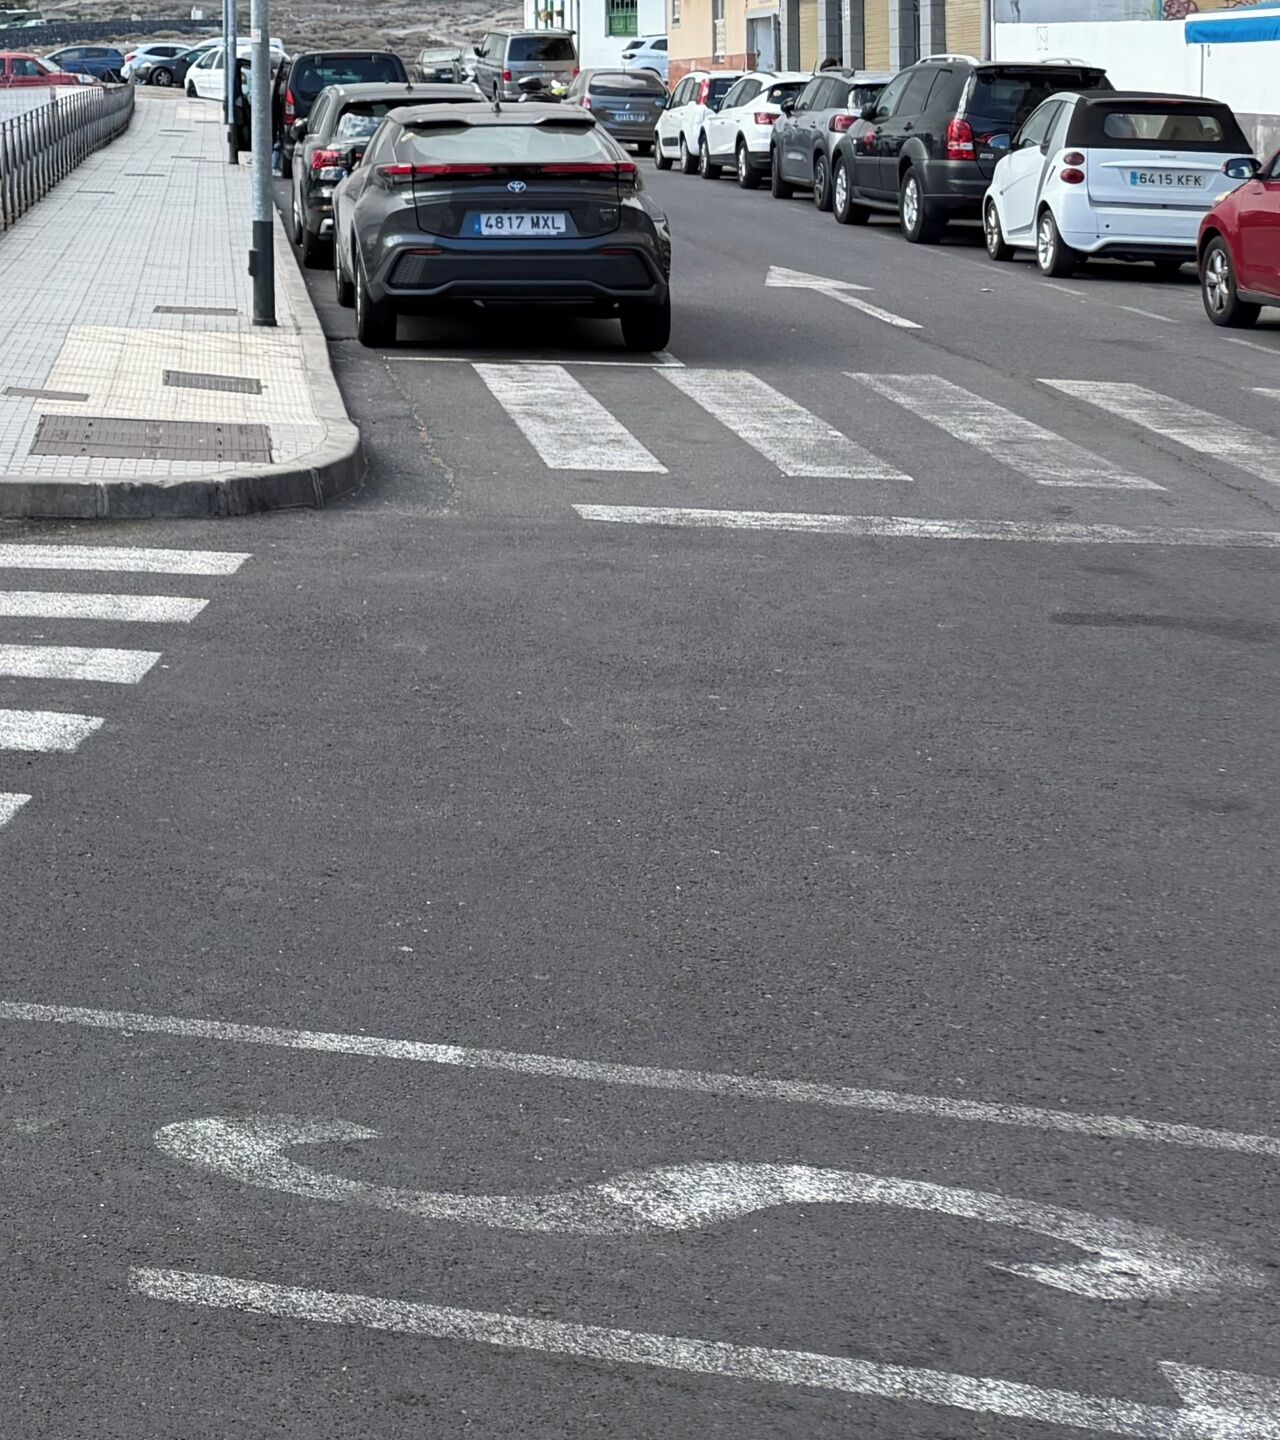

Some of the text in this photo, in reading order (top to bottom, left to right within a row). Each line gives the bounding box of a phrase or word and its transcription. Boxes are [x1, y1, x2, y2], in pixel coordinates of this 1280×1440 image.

[1139, 173, 1203, 186] 6415 KFK
[485, 215, 561, 230] 4817 MXL
